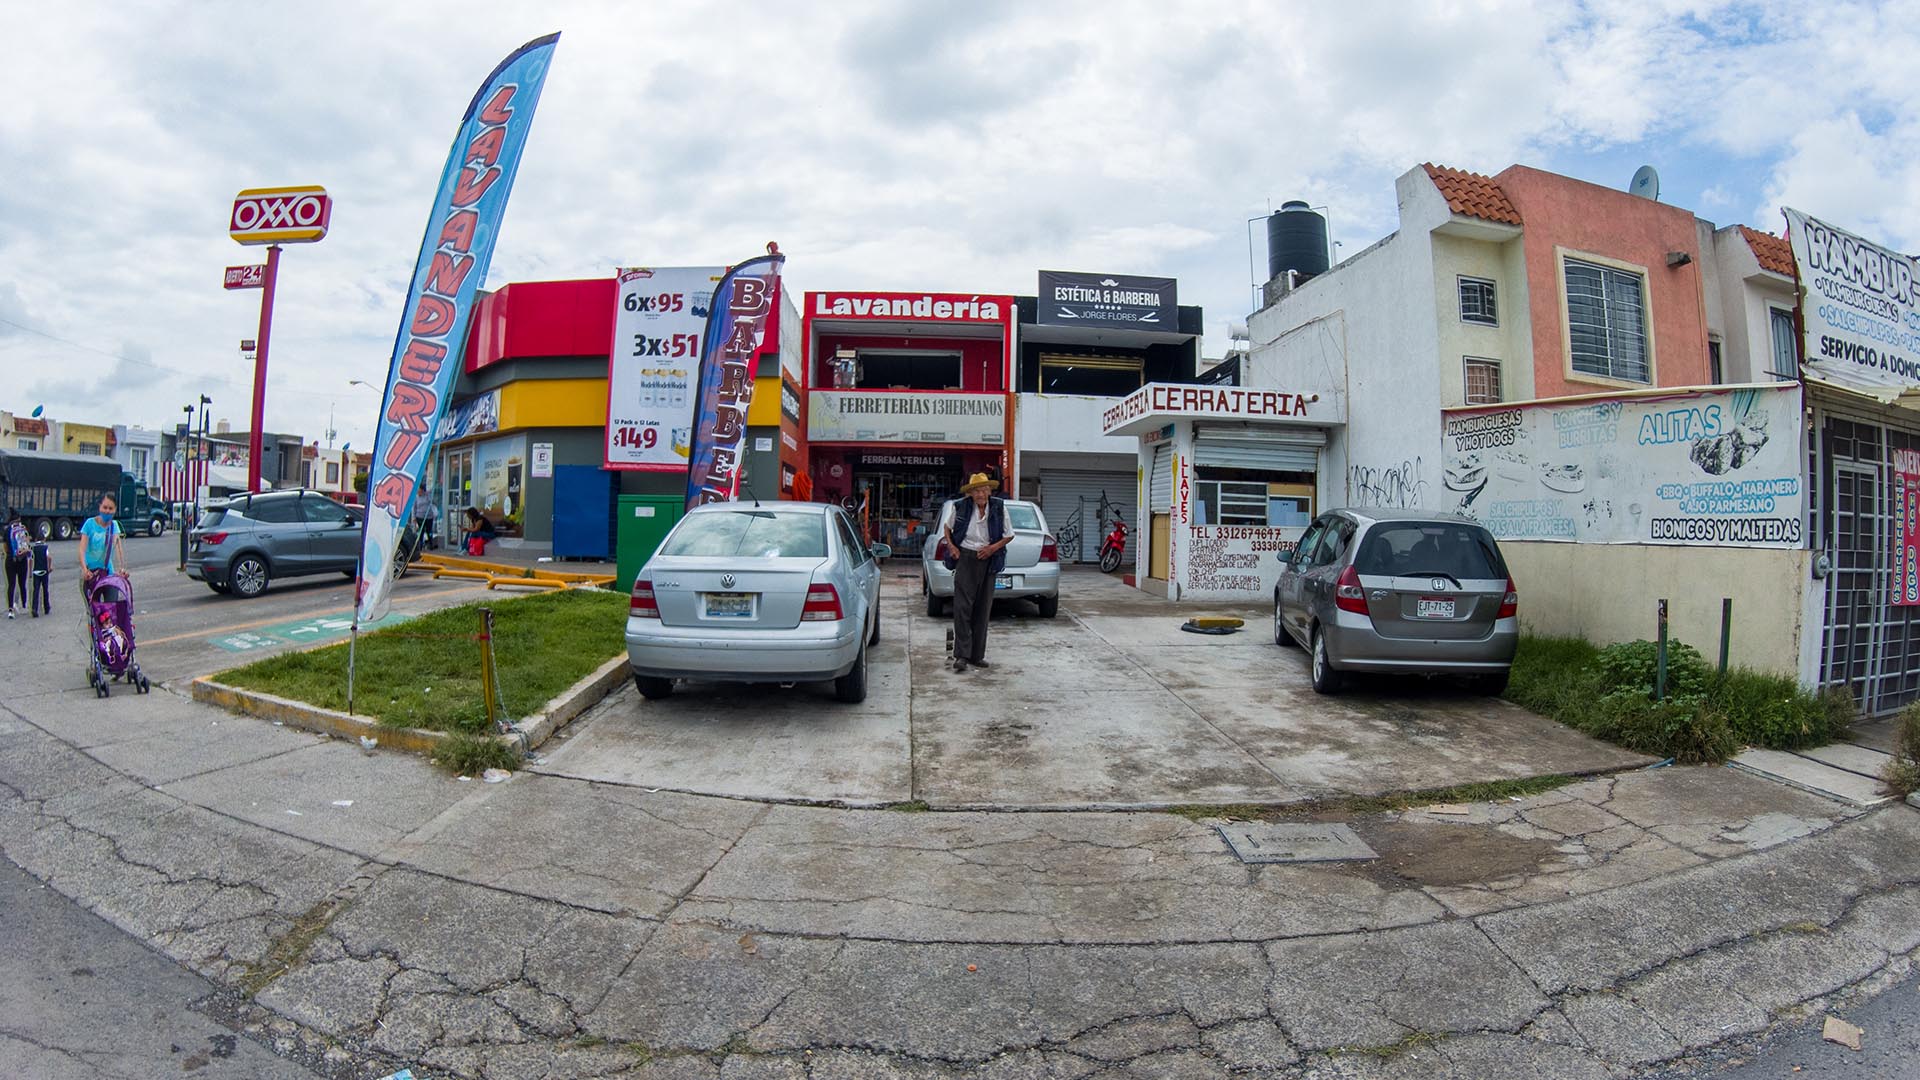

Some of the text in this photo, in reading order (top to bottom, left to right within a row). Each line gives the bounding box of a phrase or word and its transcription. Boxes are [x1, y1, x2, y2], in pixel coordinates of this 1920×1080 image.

[235, 196, 321, 229] OXXO
[372, 84, 518, 520] LAVANDERIA
[816, 294, 999, 320] Lavandería
[1055, 286, 1160, 307] ESTÉTICA & BARBERIA
[1822, 277, 1899, 323] HAMBURGUESAS
[1080, 311, 1138, 322] JORGE FLORES
[1821, 335, 1877, 367] SERVICIO
[1880, 352, 1888, 370] A
[840, 395, 1003, 416] FERRETERÍAS 13HERMANOS
[1103, 388, 1150, 432] CERRAJERIA
[1152, 386, 1307, 416] CERRAJERIA
[1448, 409, 1522, 436] HAMBURGUESAS
[1638, 405, 1722, 446] ALITAS
[614, 427, 658, 449] $149
[1456, 428, 1516, 452] Y HOT DOGS
[862, 455, 945, 466] FERREMATERIALES
[1180, 456, 1189, 524] LLAVES
[1662, 484, 1683, 500] BBQ
[1689, 482, 1735, 498] BUFFALO
[1685, 496, 1775, 514] AJO PARMESANO
[1189, 526, 1210, 538] TEL
[1652, 518, 1800, 542] BIONICOS Y MALTEDAS
[1188, 568, 1200, 576] CON
[1906, 545, 1918, 601] DOGS
[1188, 582, 1218, 591] SERVICIO
[1419, 602, 1454, 612] EJT-71-25
